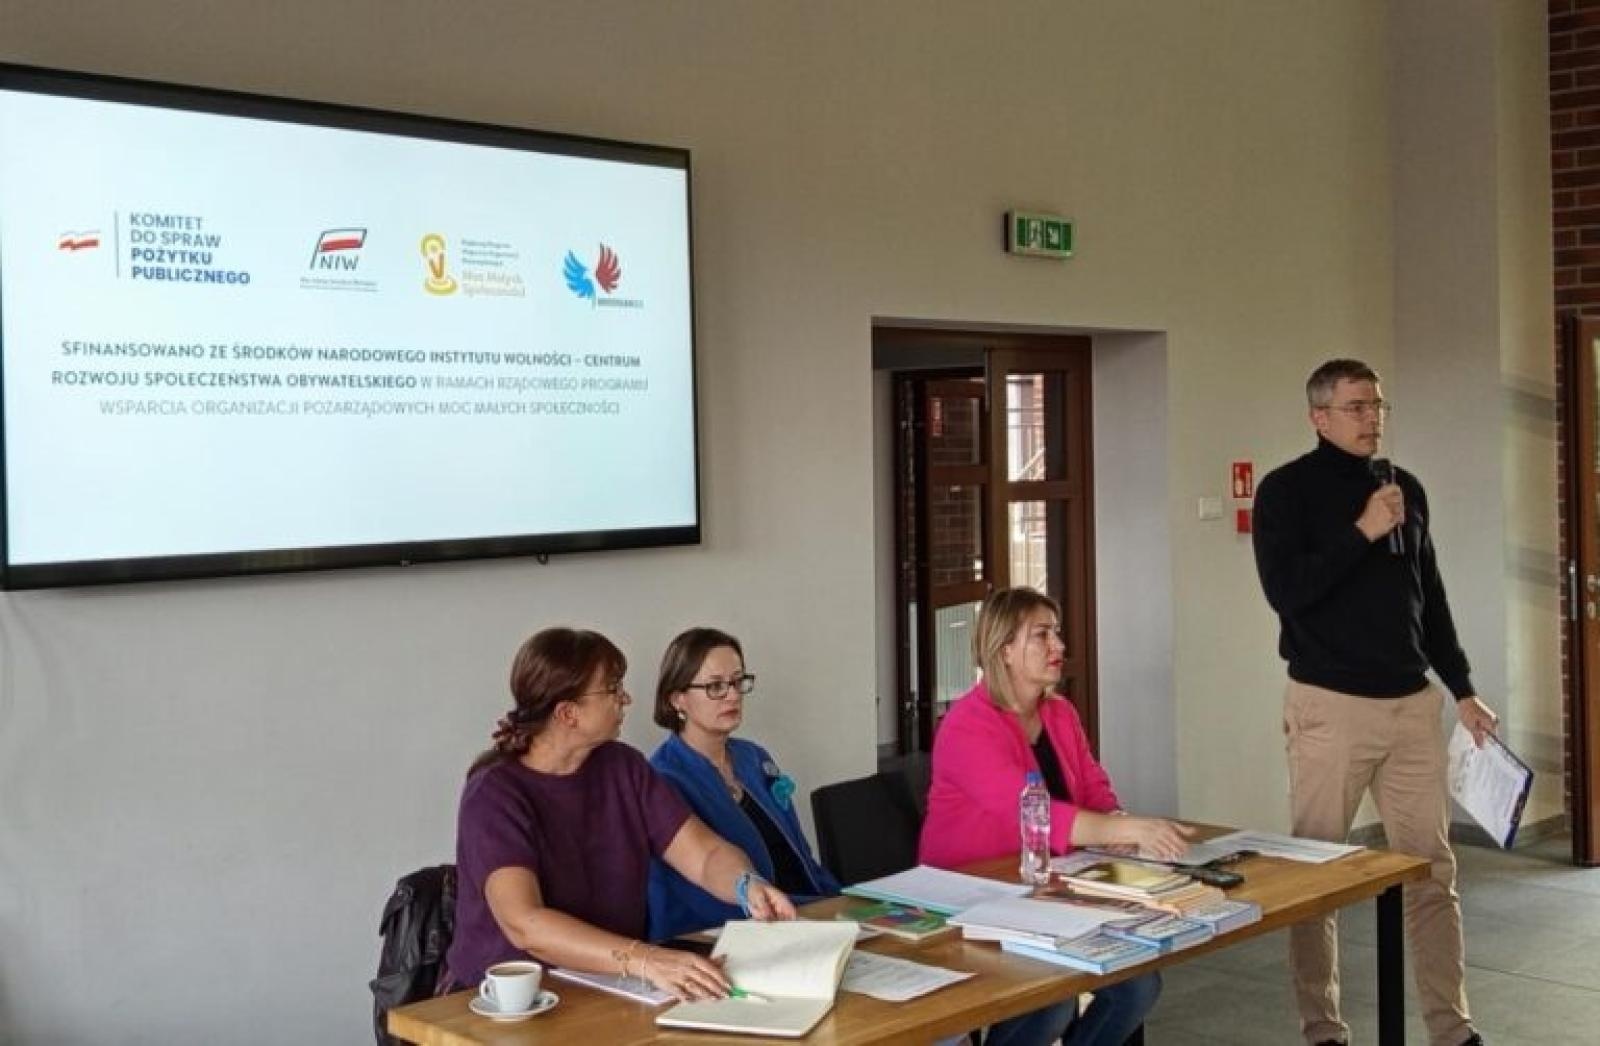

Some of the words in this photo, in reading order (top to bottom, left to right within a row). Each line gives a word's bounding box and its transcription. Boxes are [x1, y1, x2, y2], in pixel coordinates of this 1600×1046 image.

[130, 212, 203, 230] KOMITET
[130, 229, 157, 244] DO
[160, 231, 222, 248] SPRAW
[318, 256, 360, 271] NIW
[132, 266, 251, 286] PUBLICZNEGO
[61, 341, 206, 358] SFINANSOWANO
[209, 345, 228, 359] ZE
[232, 342, 314, 361] ŚRODKÓW
[318, 348, 426, 363] NARODOWEGO
[430, 351, 500, 365] INSTYTUTU
[504, 350, 572, 366] WOLNOŚCI
[584, 353, 641, 367] CENTRUM
[51, 370, 139, 386] ROZWOJU
[286, 374, 417, 389] OBYWATELSKIEGO
[420, 377, 433, 389] W
[99, 400, 188, 415] WSPARCIA
[191, 400, 299, 415] ORGANIZACJI
